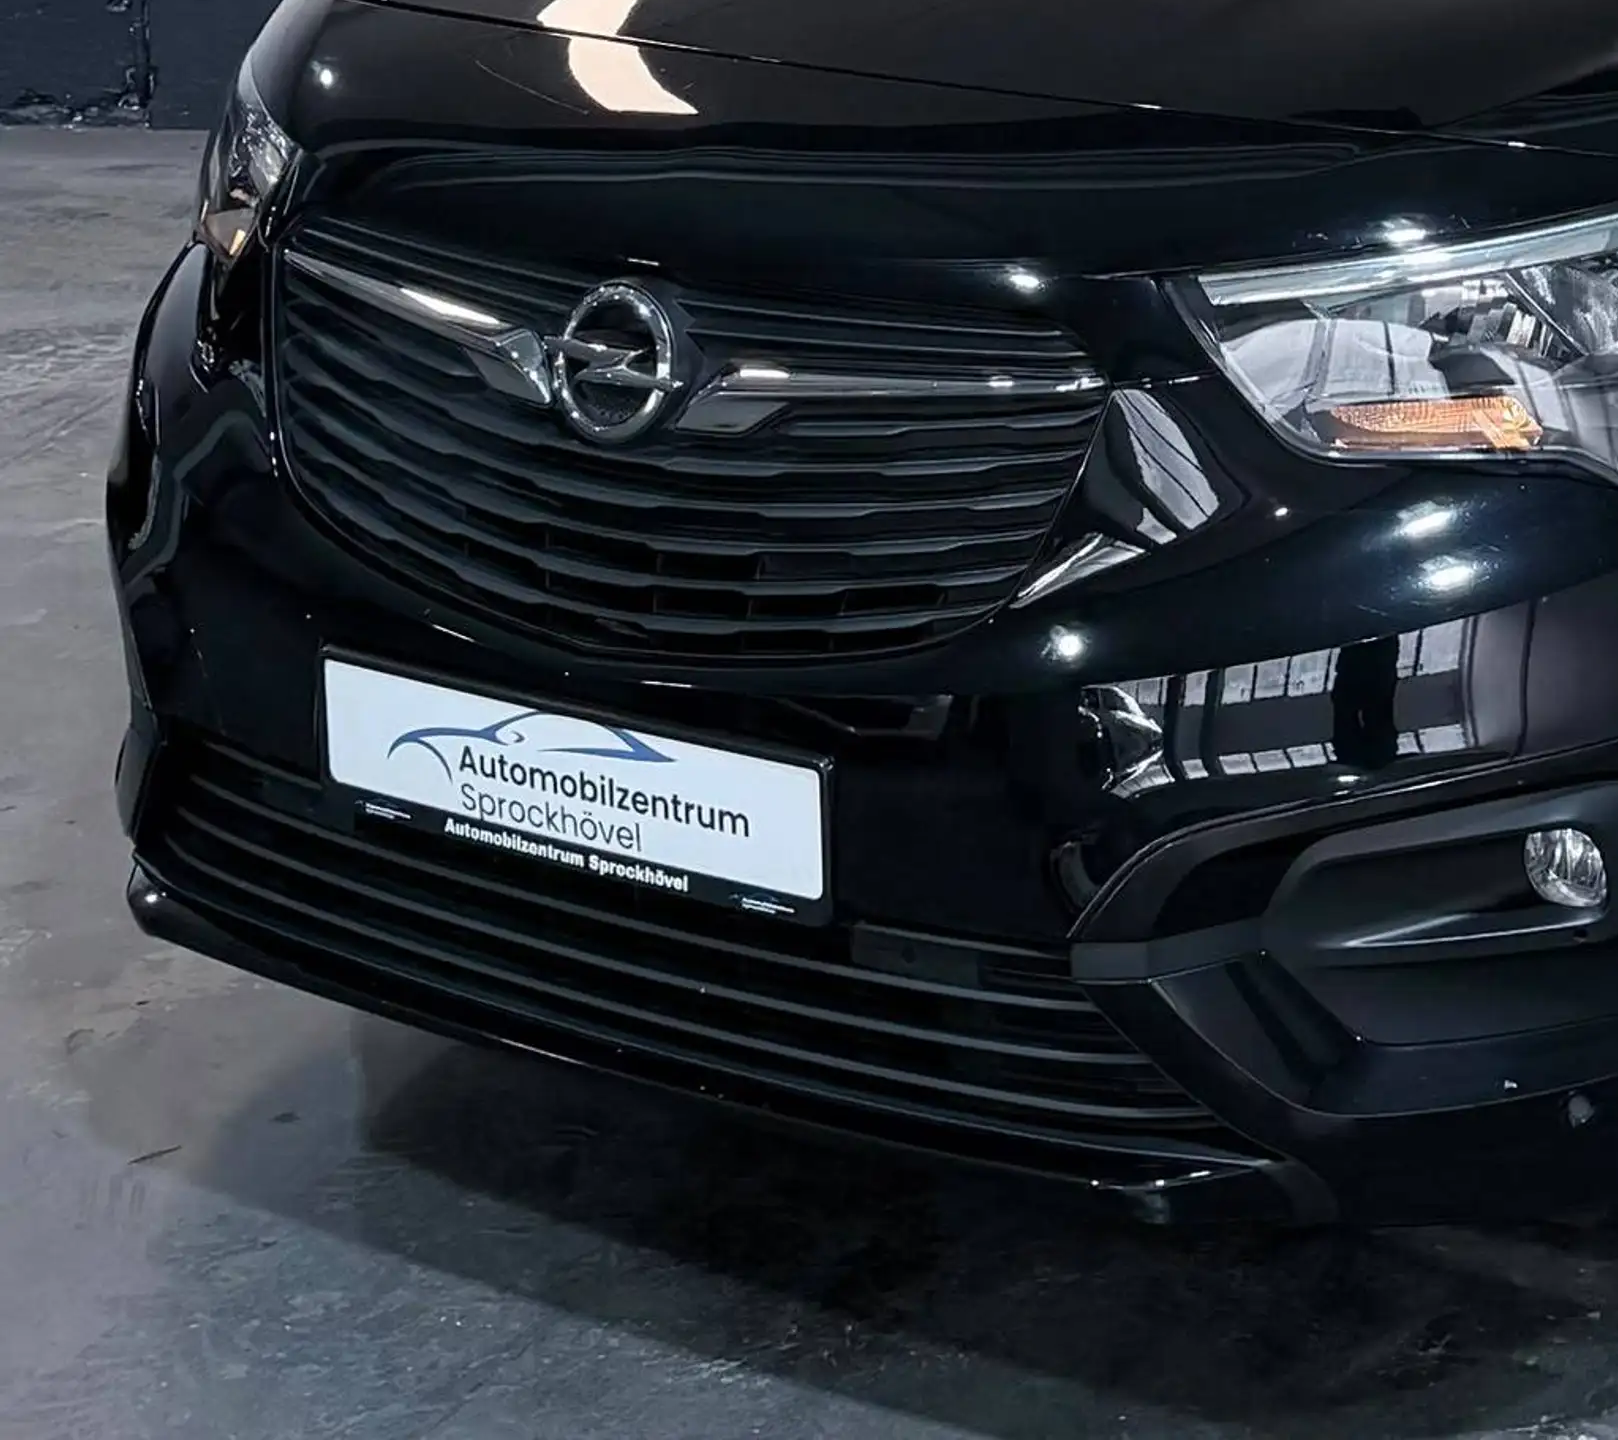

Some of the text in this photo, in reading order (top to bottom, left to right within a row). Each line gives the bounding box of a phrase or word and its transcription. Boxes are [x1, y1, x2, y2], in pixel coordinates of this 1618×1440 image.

[459, 745, 751, 838] Automobilzentrum
[461, 782, 642, 852] Sprockhövel
[444, 816, 690, 892] Automobilzentrum Sprockhövel
